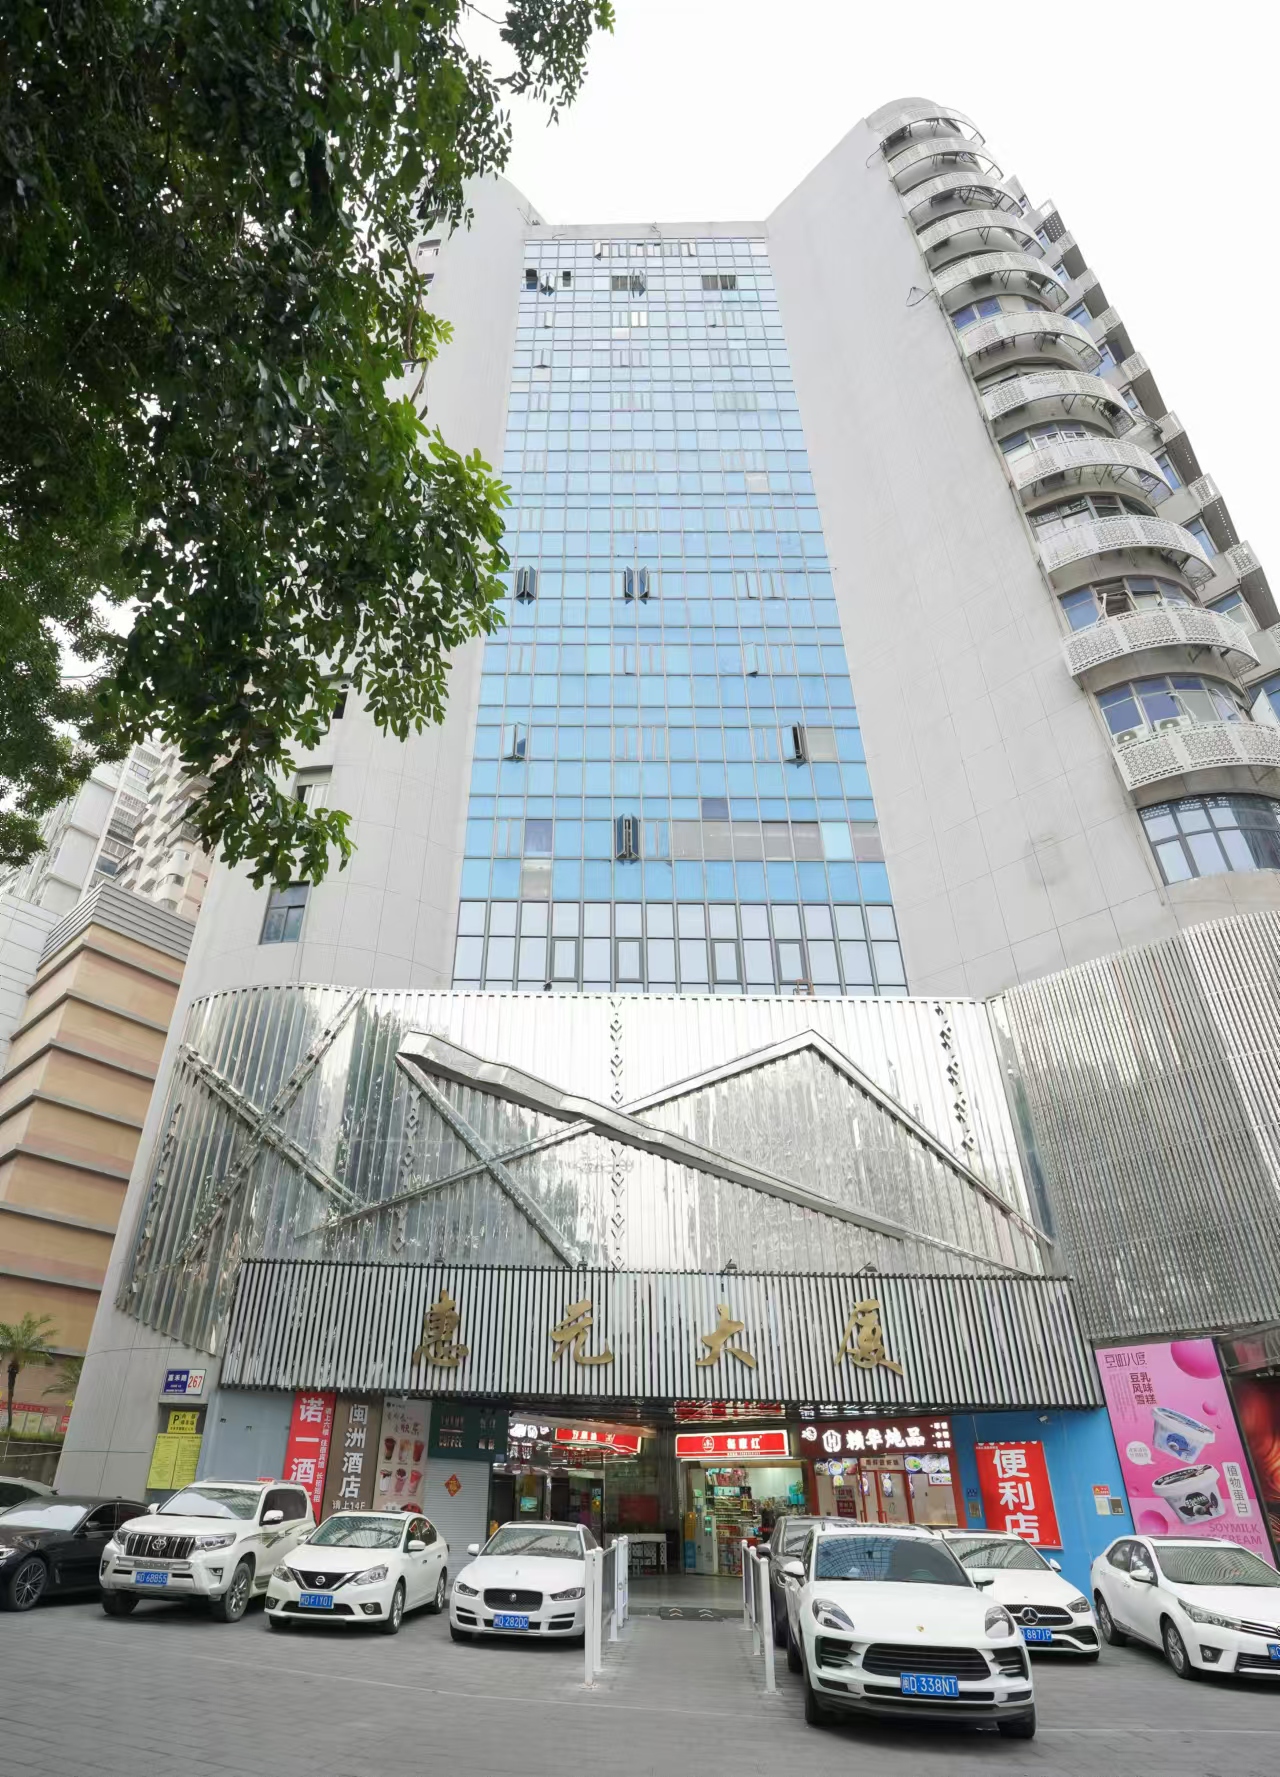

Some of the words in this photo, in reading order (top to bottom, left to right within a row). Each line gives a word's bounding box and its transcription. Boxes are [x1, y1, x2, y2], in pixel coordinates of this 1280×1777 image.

[188, 1375, 203, 1388] 267
[1129, 1372, 1150, 1383] 豆乳
[1132, 1383, 1154, 1394] 风味
[1134, 1393, 1157, 1405] 雪糕
[173, 1414, 180, 1425] P
[289, 1397, 325, 1496] 诺一酒
[338, 1404, 369, 1499] 闽洲酒店
[1227, 1465, 1248, 1513] 植物蛋白
[992, 1449, 1040, 1543] 便利店
[1209, 1523, 1260, 1533] SOYMILK
